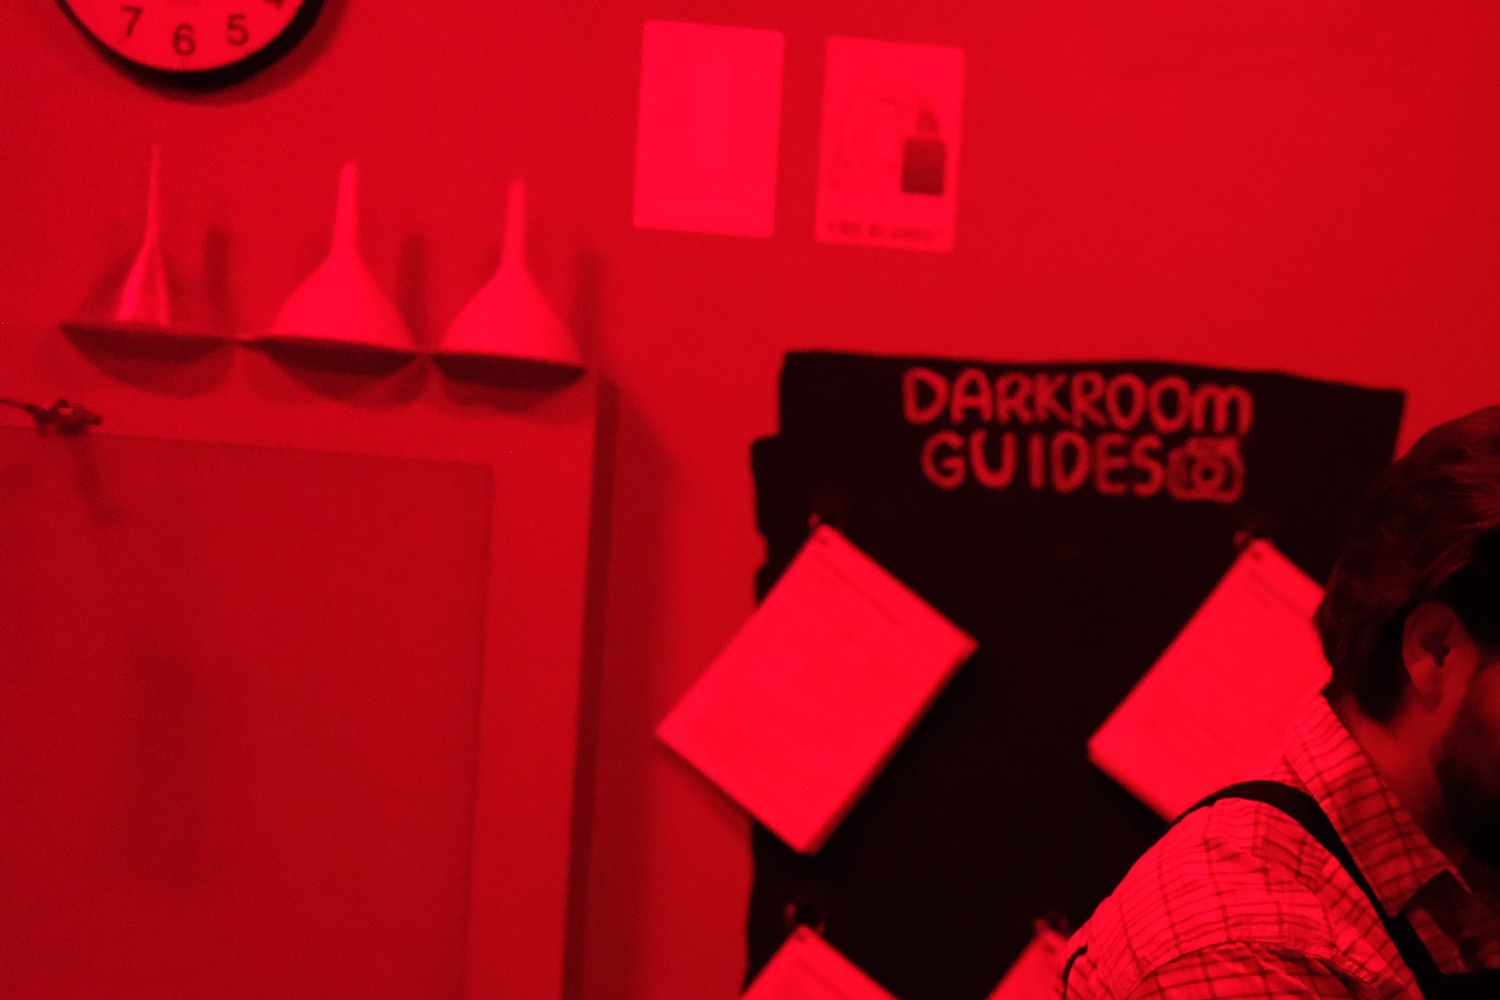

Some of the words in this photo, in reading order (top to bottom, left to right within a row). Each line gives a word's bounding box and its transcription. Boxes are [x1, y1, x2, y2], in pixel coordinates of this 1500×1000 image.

[120, 5, 143, 38] 7
[226, 13, 249, 46] 5
[172, 23, 196, 56] 6
[920, 428, 1167, 498] GUIDES
